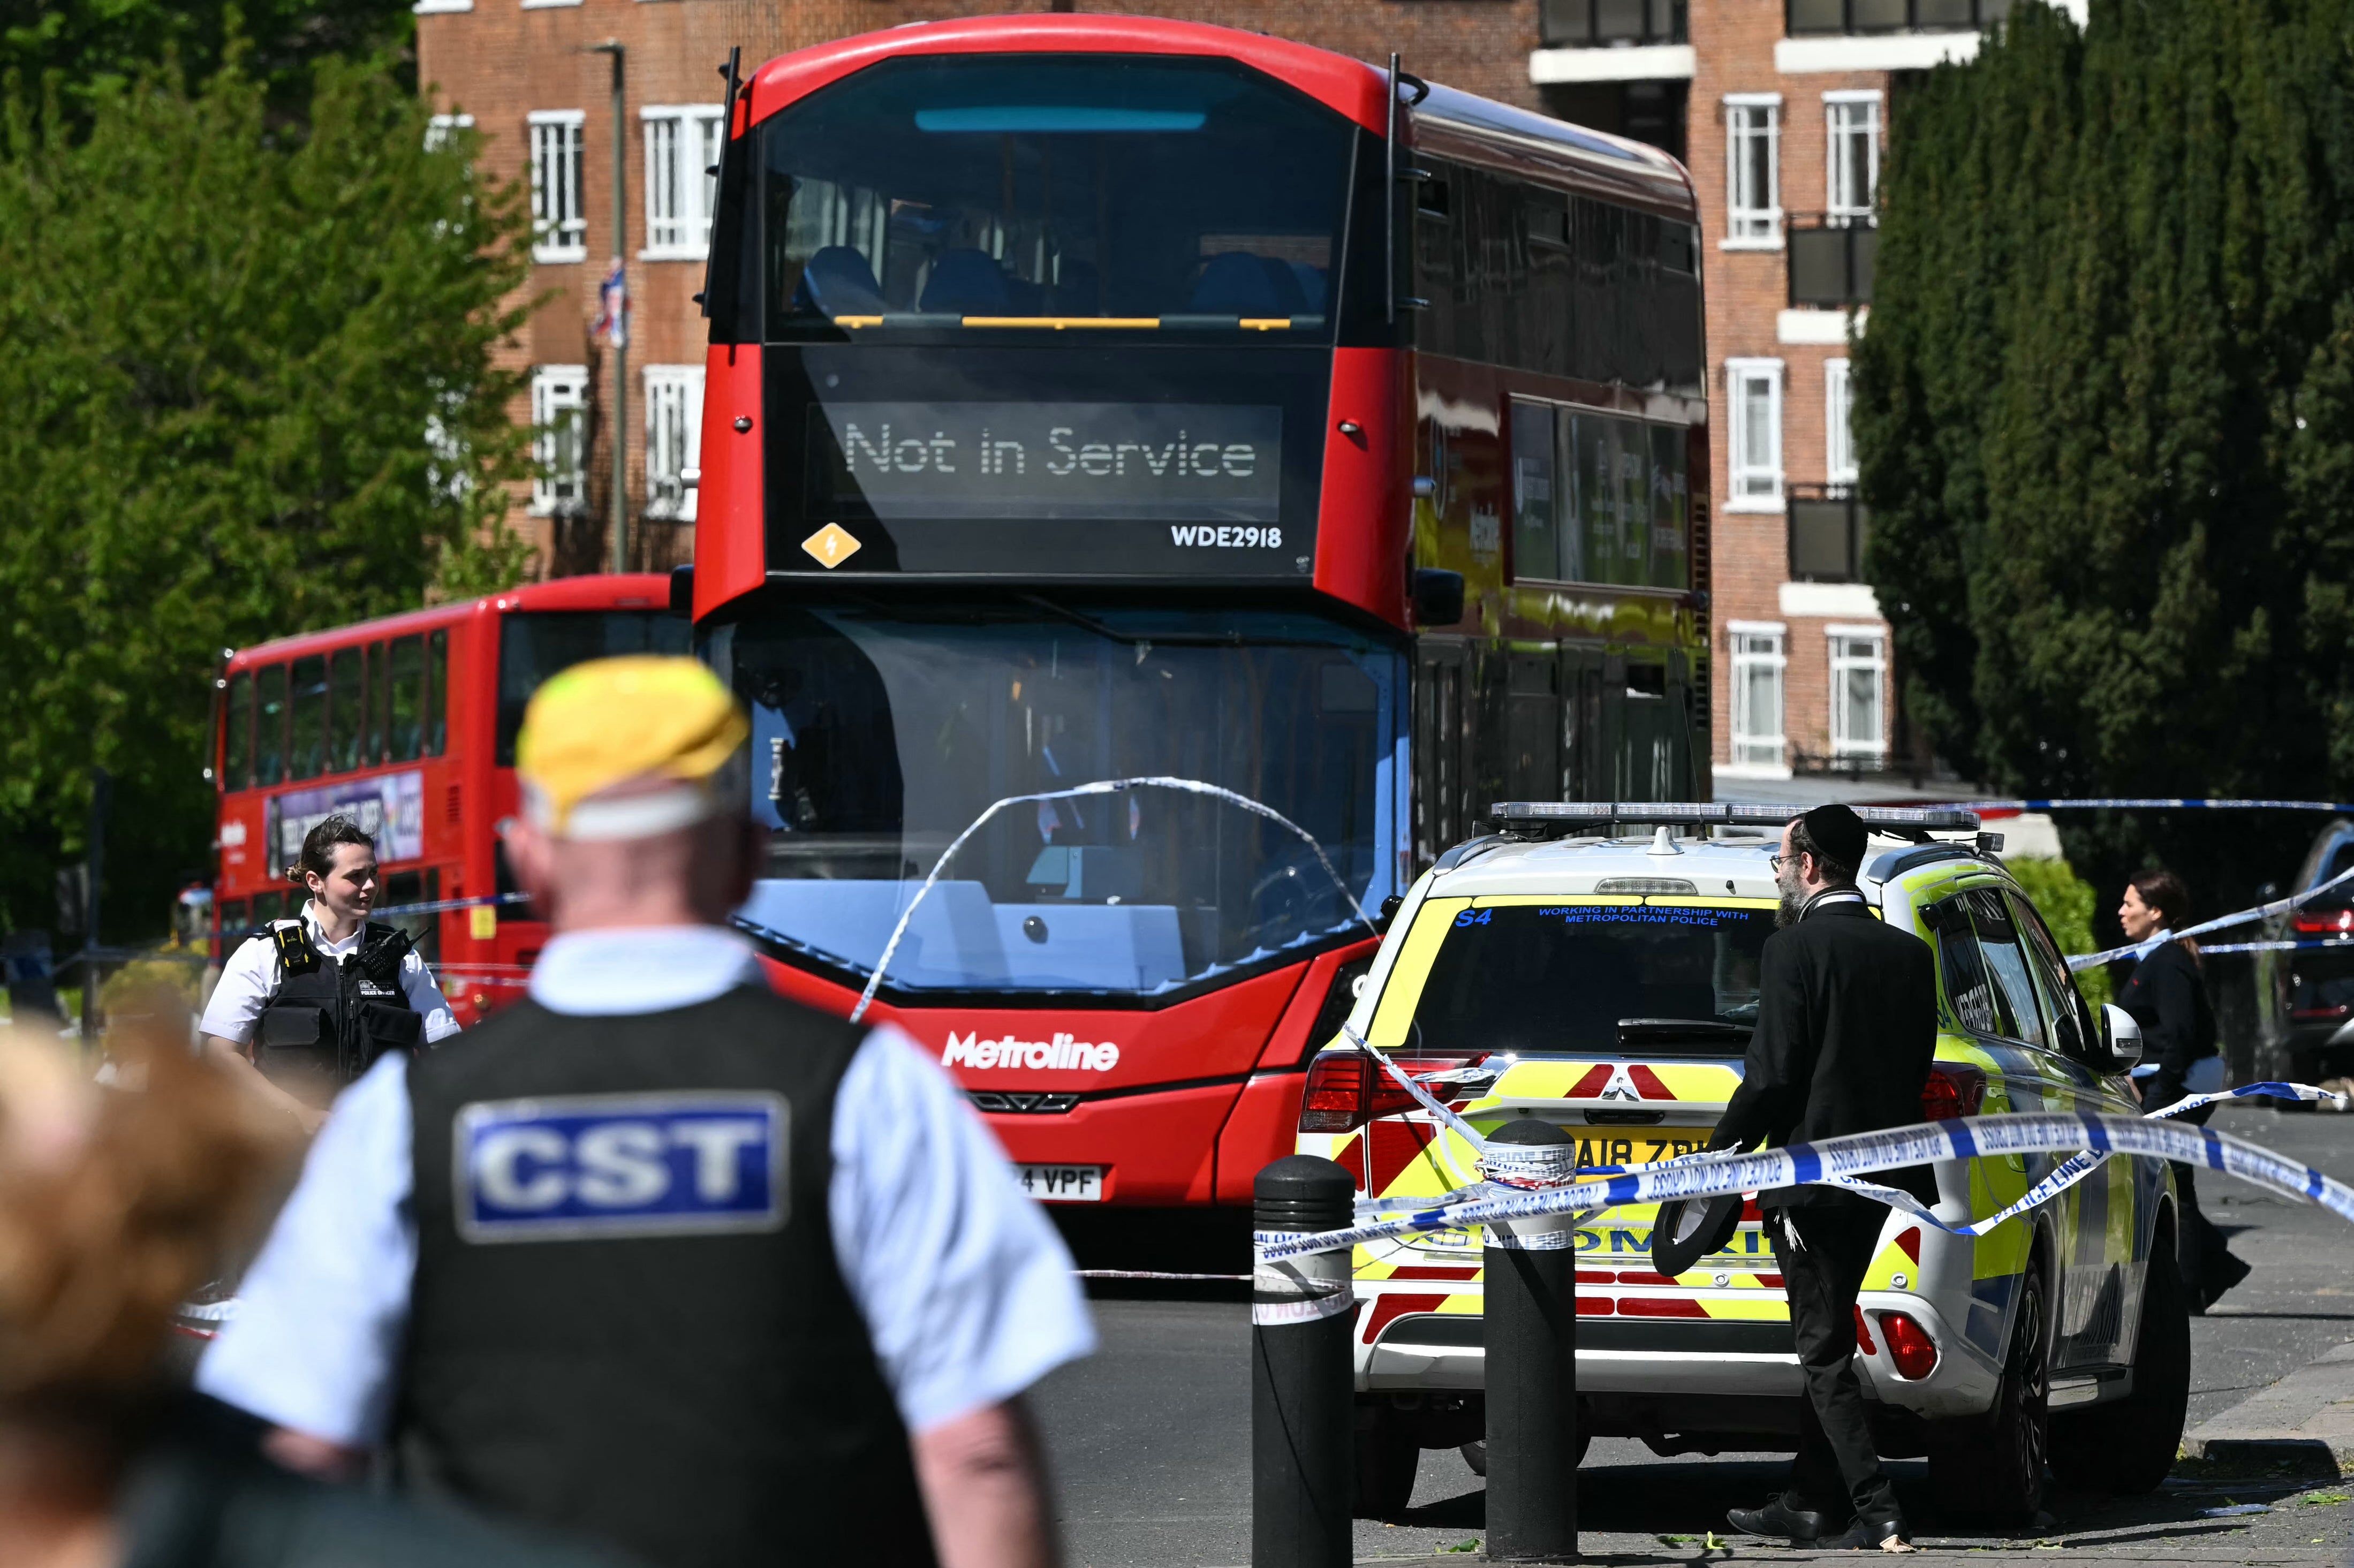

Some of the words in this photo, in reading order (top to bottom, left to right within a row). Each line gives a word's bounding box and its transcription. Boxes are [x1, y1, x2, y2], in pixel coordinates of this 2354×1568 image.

[846, 423, 956, 473] Not
[981, 428, 1025, 474] in
[1047, 428, 1256, 477] Service
[1171, 525, 1282, 549] WDE2918
[1455, 908, 1492, 928] S4
[1539, 906, 1601, 916] WORKING
[1621, 906, 1713, 916] PARTNERSHIP
[1716, 910, 1749, 920] WITH
[1565, 914, 1667, 923] METROPOLITAN
[1670, 915, 1719, 926] POLICE
[941, 1030, 1120, 1071] Metroline
[476, 1118, 763, 1211] CST
[2050, 1156, 2092, 1188] LINE
[1043, 1169, 1095, 1194] VPF
